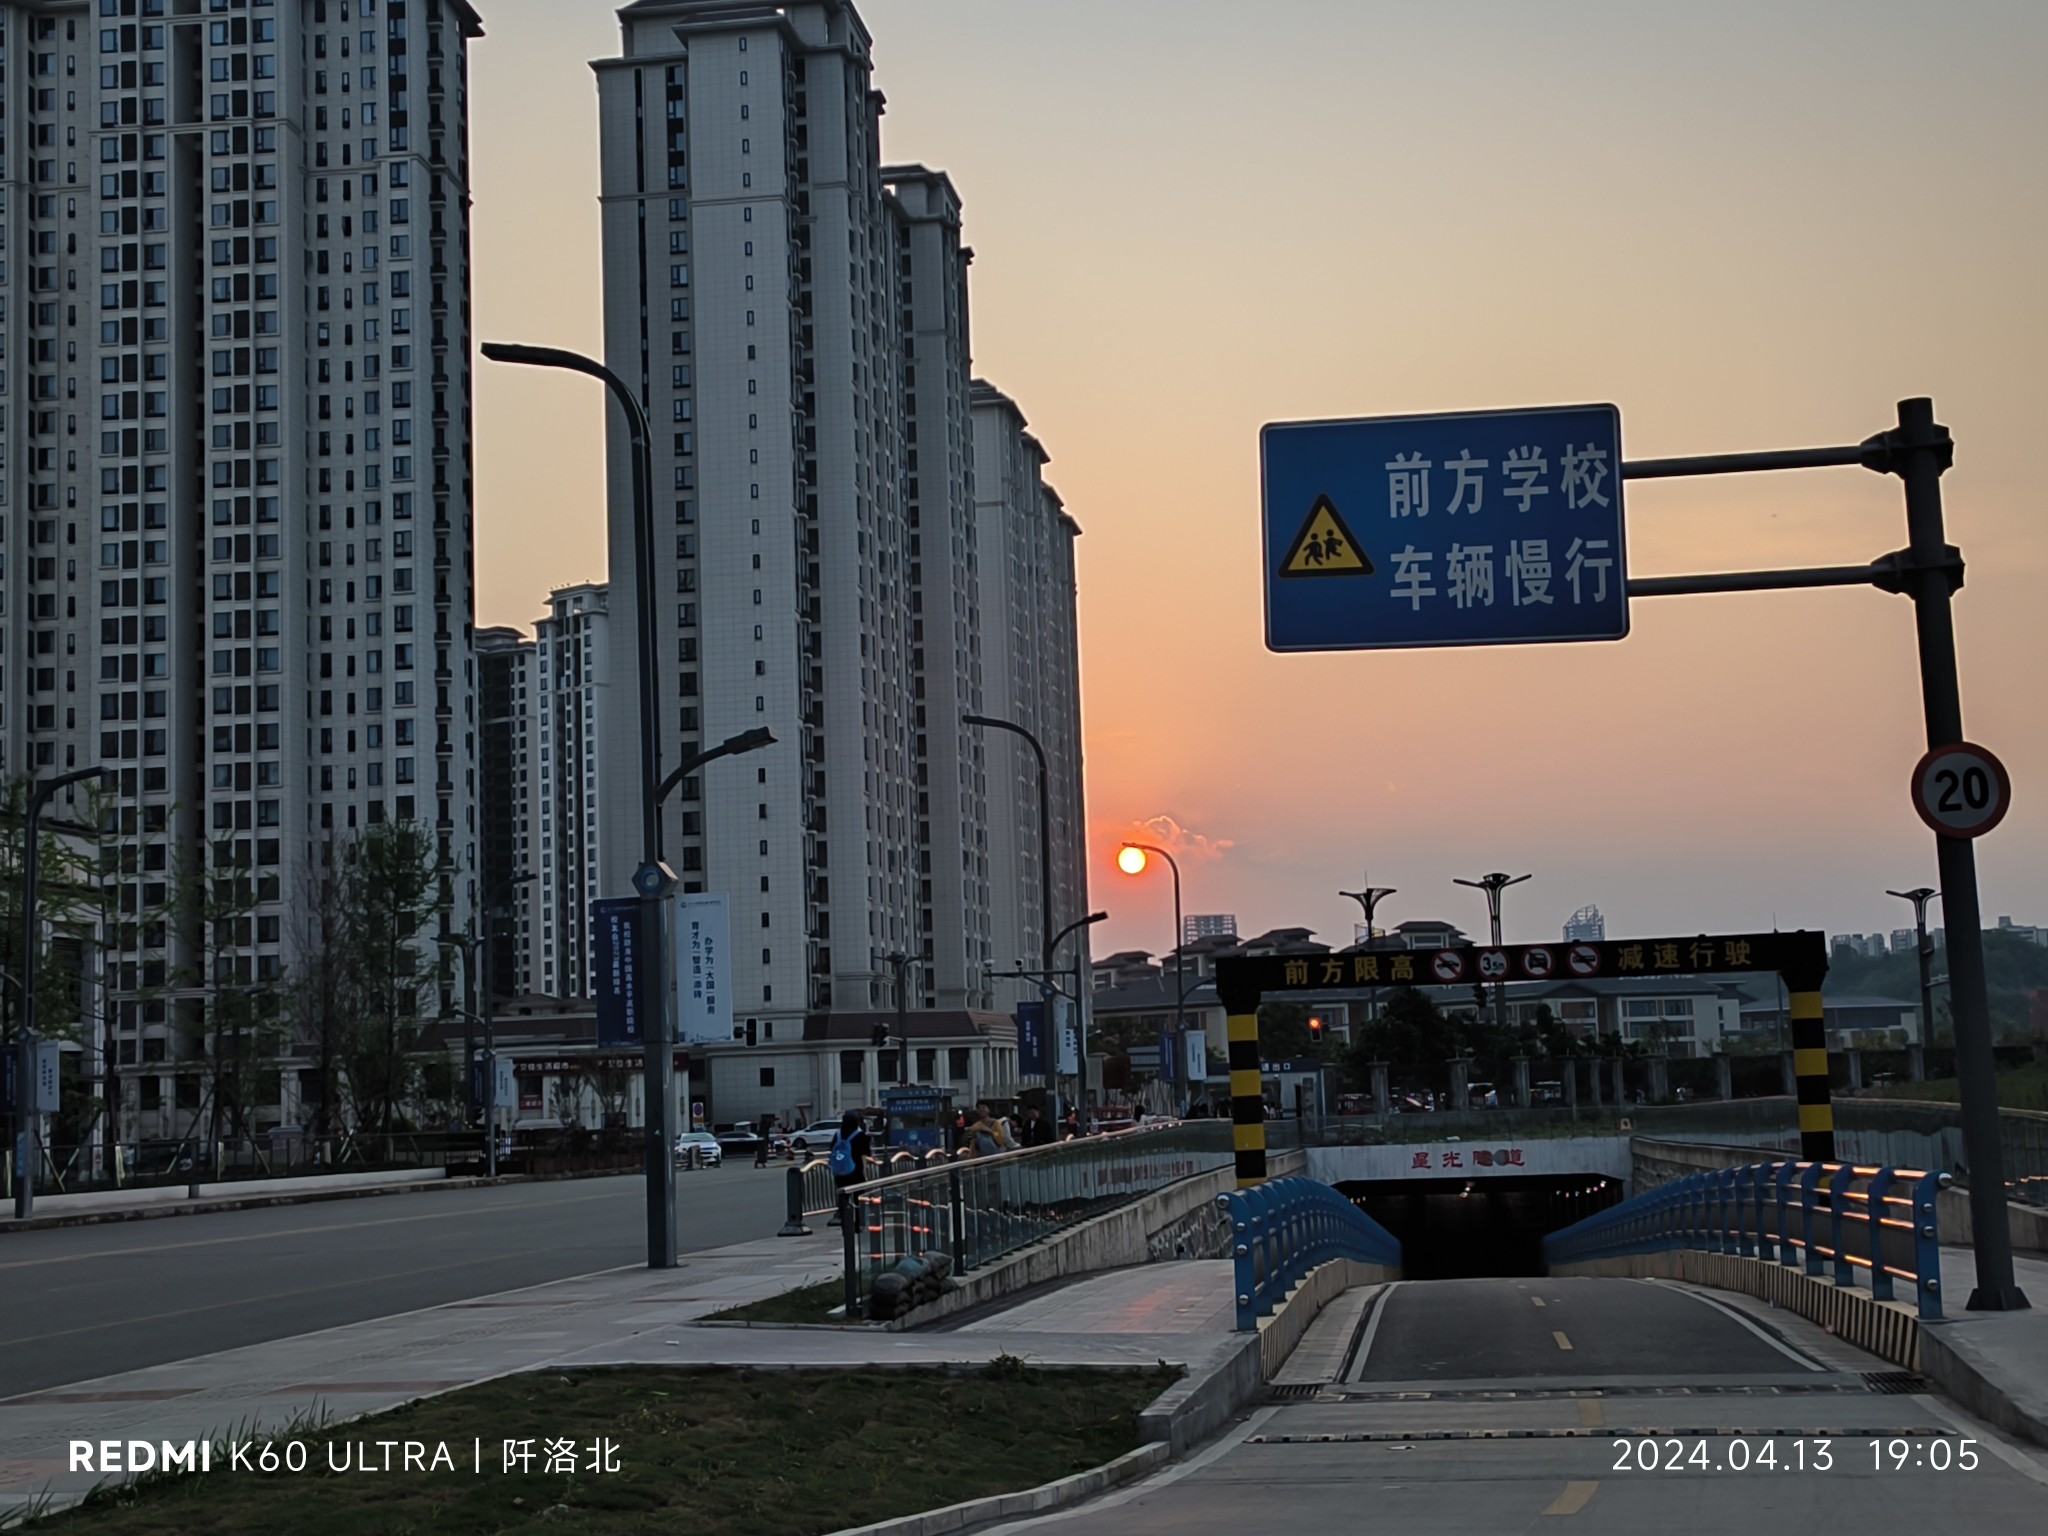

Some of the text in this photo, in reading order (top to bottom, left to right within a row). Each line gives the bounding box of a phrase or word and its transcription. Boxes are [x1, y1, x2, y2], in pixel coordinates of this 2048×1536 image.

[1385, 442, 1610, 518] 前方学校
[1390, 537, 1614, 611] 车辆慢行
[1934, 766, 1990, 812] 20
[1284, 955, 1414, 985] 前方限高
[1617, 939, 1752, 971] 减速行驶
[1411, 1149, 1526, 1169] 星光隧道
